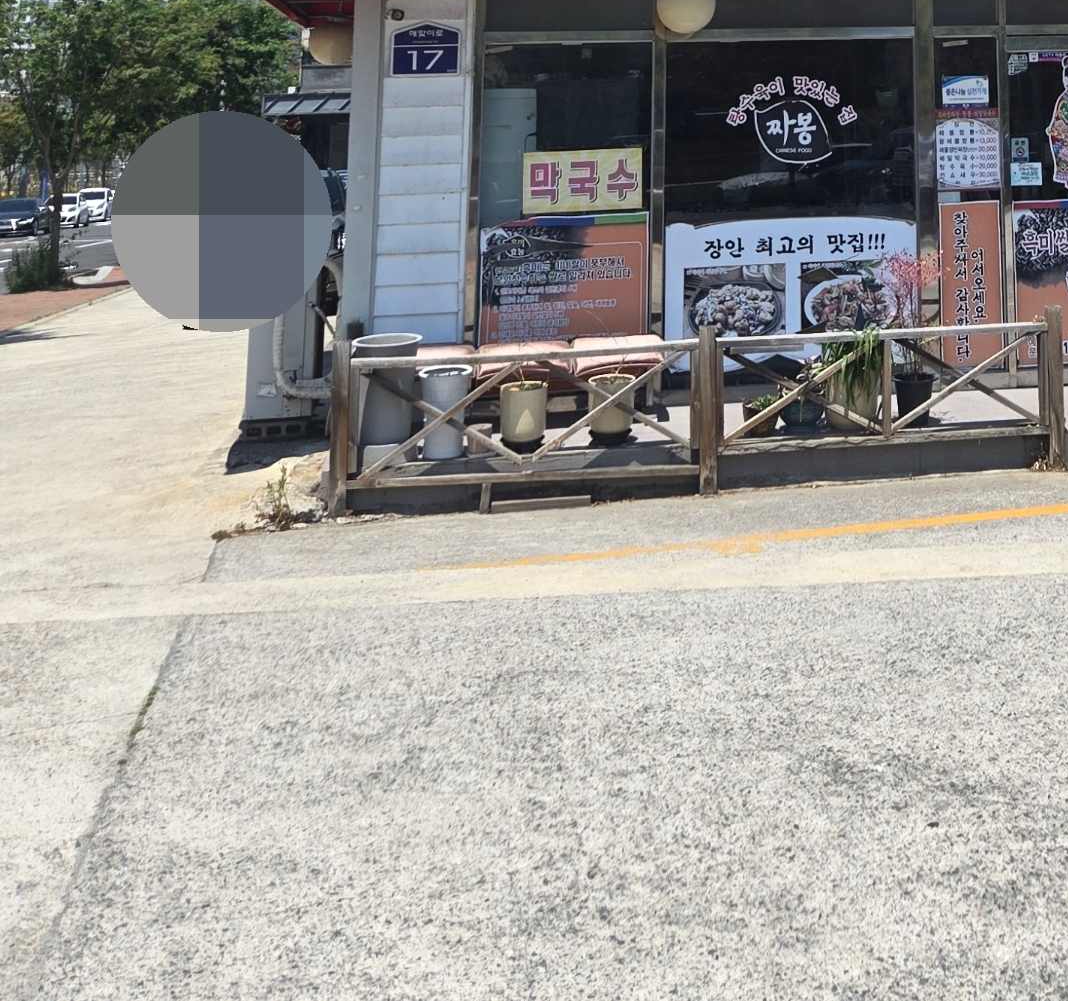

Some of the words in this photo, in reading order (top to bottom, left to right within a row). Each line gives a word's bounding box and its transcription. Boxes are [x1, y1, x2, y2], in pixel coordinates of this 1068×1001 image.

[407, 49, 444, 71] 17
[726, 76, 785, 127] 탕수육이
[793, 76, 840, 107] 맛있는
[838, 105, 857, 126] 집
[766, 109, 817, 146] 짜봉
[530, 158, 639, 205] 막국수
[704, 237, 744, 259] 장안
[755, 235, 815, 256] 최고의
[827, 232, 886, 254] 맛집!!!
[590, 256, 625, 269] 풍부해서
